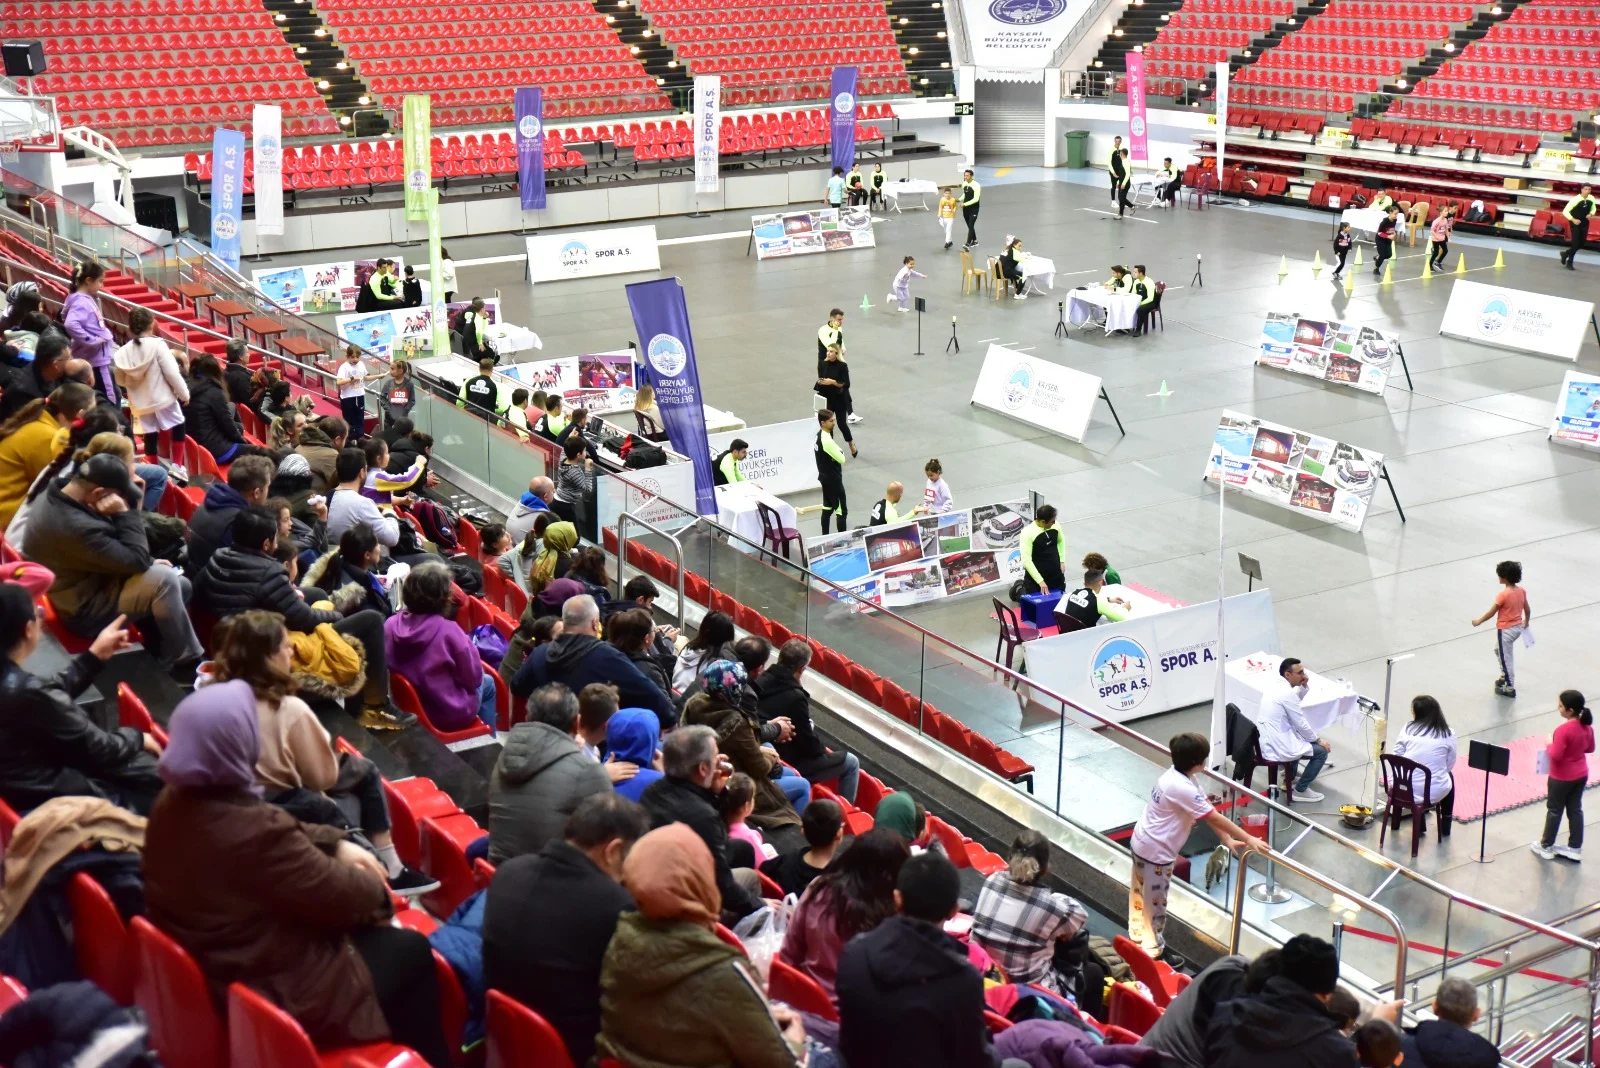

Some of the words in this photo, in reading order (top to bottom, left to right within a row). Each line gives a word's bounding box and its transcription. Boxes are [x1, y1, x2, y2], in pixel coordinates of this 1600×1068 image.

[705, 88, 715, 108] A.Ş.
[705, 112, 714, 142] SPOR
[223, 173, 236, 210] SPOR
[594, 249, 615, 259] SPOR
[617, 247, 632, 257] A.Ş.
[1517, 309, 1544, 320] KAYSERİ
[738, 456, 784, 471] ÜYÜKŞEHİR
[748, 448, 767, 459] SERİ
[1160, 651, 1199, 672] SPOR
[1099, 683, 1127, 698] SPOR
[1130, 677, 1150, 690] A.Ş.
